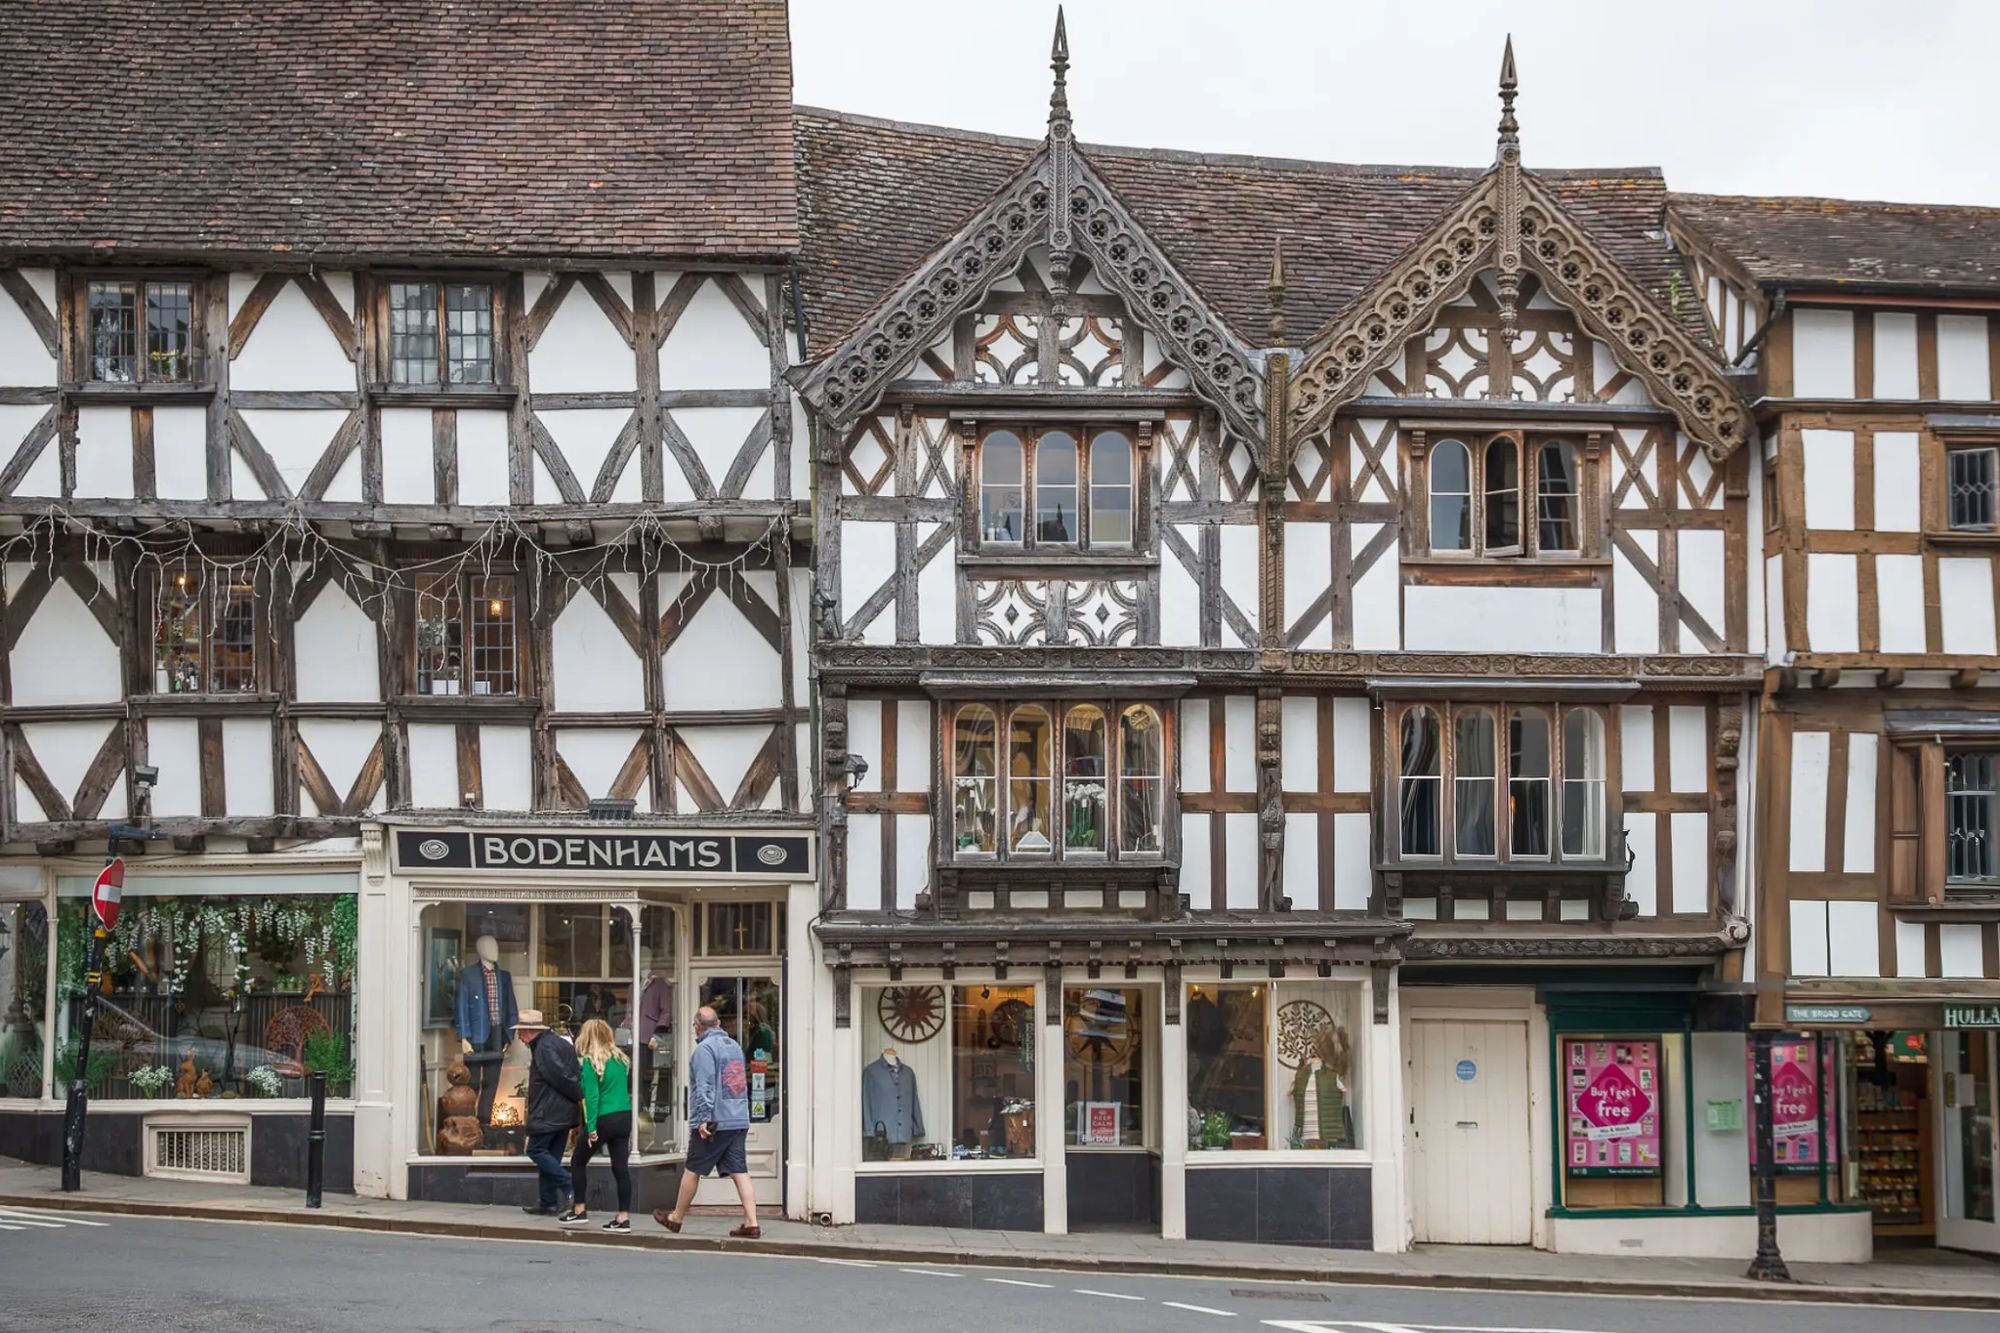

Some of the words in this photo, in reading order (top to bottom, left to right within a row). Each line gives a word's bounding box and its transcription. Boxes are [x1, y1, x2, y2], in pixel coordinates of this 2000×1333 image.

[484, 837, 721, 867] BODENHAMS
[1792, 1009, 1809, 1018] THE
[1812, 1009, 1840, 1018] BROAD
[1841, 1009, 1863, 1018] GATE
[1591, 1087, 1608, 1100] Buy
[1609, 1087, 1614, 1096] 1
[1616, 1088, 1630, 1100] get
[1631, 1087, 1636, 1096] 1
[1793, 1086, 1807, 1097] get
[1598, 1100, 1631, 1117] free
[1775, 1097, 1807, 1114] free
